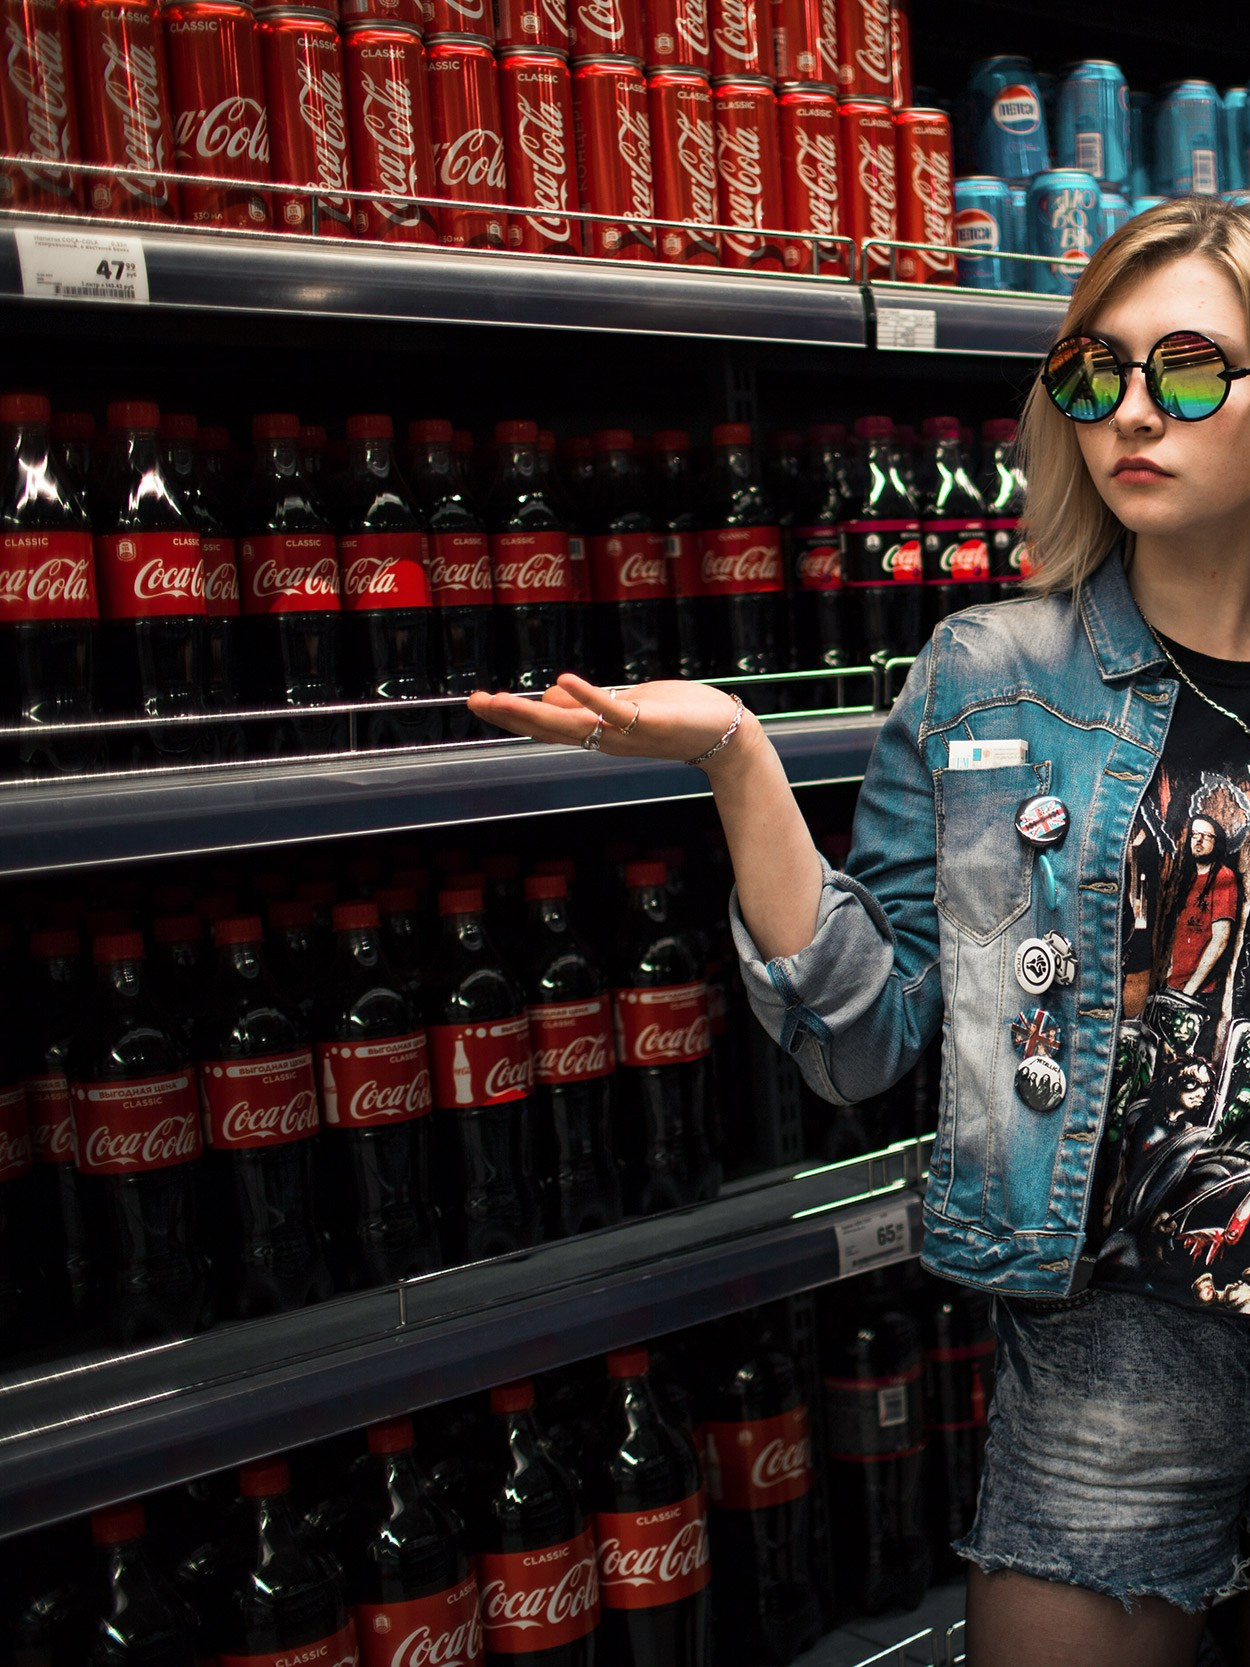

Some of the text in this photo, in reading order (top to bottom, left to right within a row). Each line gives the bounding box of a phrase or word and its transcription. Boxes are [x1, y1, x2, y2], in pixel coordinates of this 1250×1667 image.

[101, 9, 151, 25] CLASSIC
[169, 20, 219, 33] CLASSIC
[297, 38, 337, 52] CLASSIC
[361, 49, 406, 60] CLASSIC
[517, 72, 559, 84] CLASSIC
[6, 16, 74, 198] Coca-Cola
[716, 101, 756, 110] CLASSIC
[796, 109, 833, 118] CLASSIC
[101, 32, 168, 206] Coca-Cola
[859, 118, 893, 129] CLASSIC
[297, 58, 354, 223] Coca-Cola
[911, 127, 947, 136] CLASSIC
[360, 70, 421, 227] Coca-Cola
[517, 92, 572, 242] Coca-Cola
[616, 100, 658, 249] Coca-Cola
[676, 109, 720, 254] Coca-Cola
[716, 121, 765, 258] Coca-Cola
[795, 126, 842, 263] Coca-Cola
[858, 135, 898, 266] Coca-Cola
[193, 211, 211, 222] 330
[911, 143, 955, 272] Coca-Cola
[96, 259, 136, 281] 47 99
[5, 537, 48, 548] CLASSIC
[286, 538, 321, 548] CLASSIC
[500, 537, 535, 546] CLASSIC
[702, 545, 778, 583] Coca-Cola
[368, 1041, 412, 1054] ВЫГОДНАЯ
[239, 1064, 288, 1075] ВЫГОДНАЯ
[262, 1072, 297, 1084] CLASSIC
[99, 1083, 178, 1100] ВЫГОДНАЯ ЦЕНА
[122, 1097, 163, 1109] CLASSIC
[85, 1112, 196, 1167] Coca-Cola
[877, 1224, 896, 1247] 65
[635, 1507, 681, 1526] CLASSIC
[522, 1546, 571, 1567] CLASSIC
[274, 1646, 329, 1667] CLASSIC
